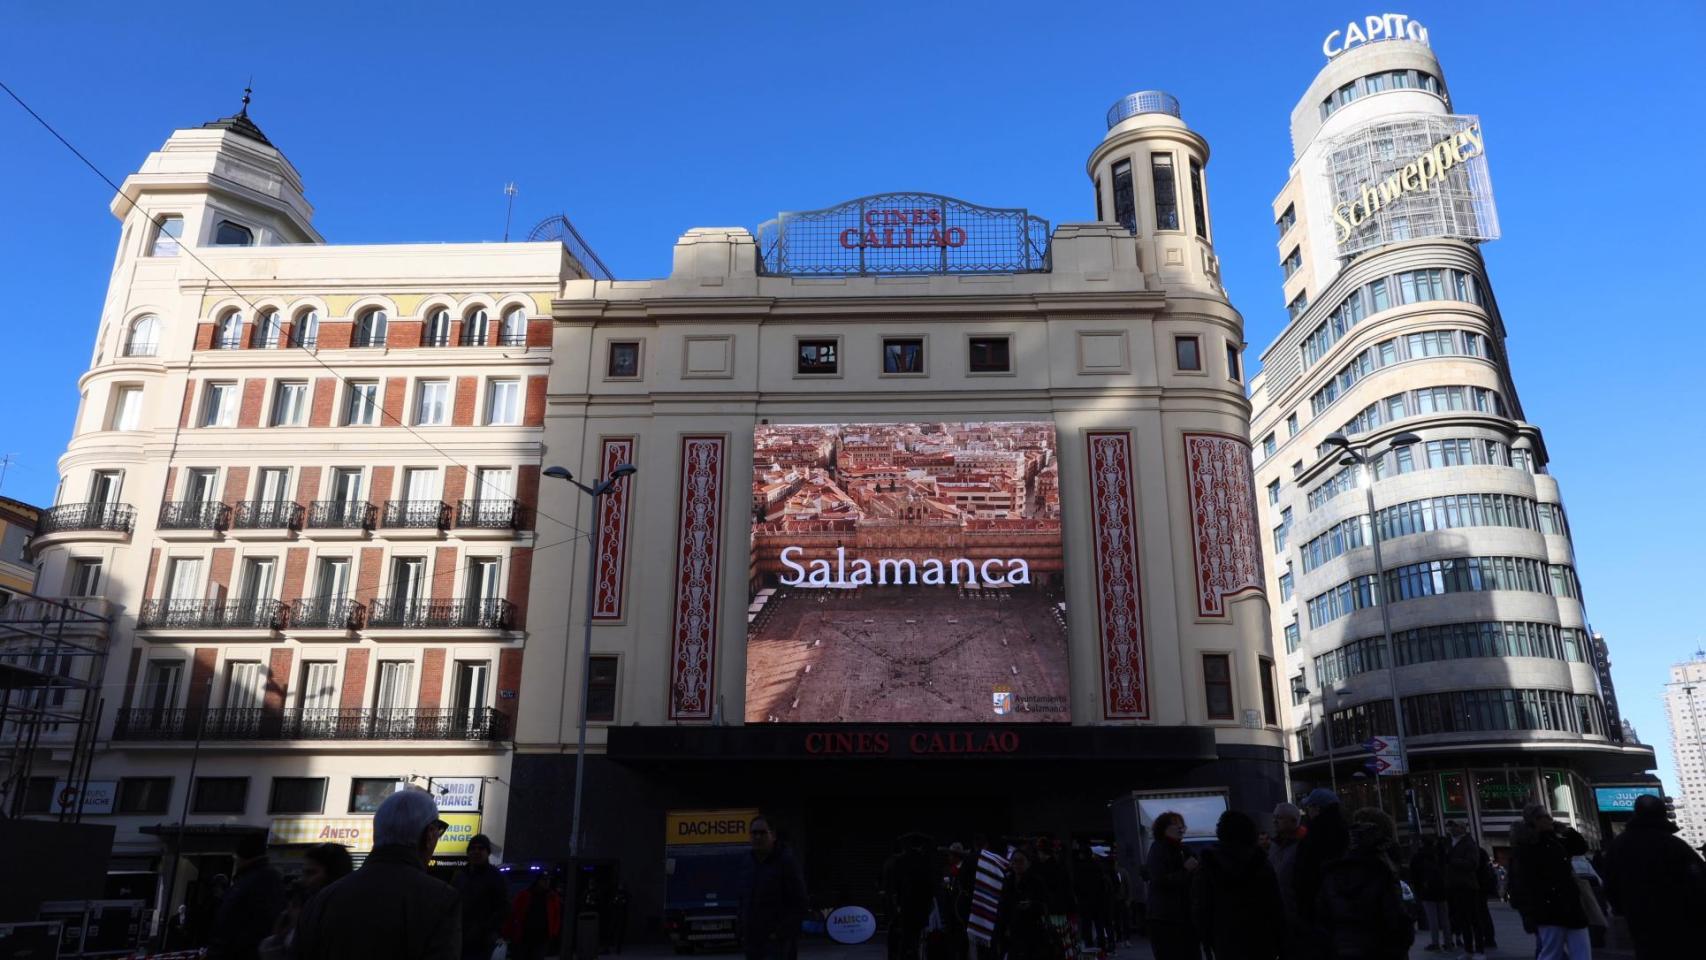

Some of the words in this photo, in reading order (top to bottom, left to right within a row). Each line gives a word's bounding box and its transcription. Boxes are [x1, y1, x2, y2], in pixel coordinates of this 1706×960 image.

[1333, 124, 1483, 244] Schweppes
[865, 208, 942, 225] CINES
[839, 227, 968, 249] CALLAO
[779, 546, 1031, 585] Salamanca
[1015, 695, 1068, 704] Ayuntamiento
[805, 731, 890, 754] CINES
[908, 731, 1021, 754] CALLAO
[319, 825, 360, 839] ANETO
[678, 820, 746, 836] DACHSER
